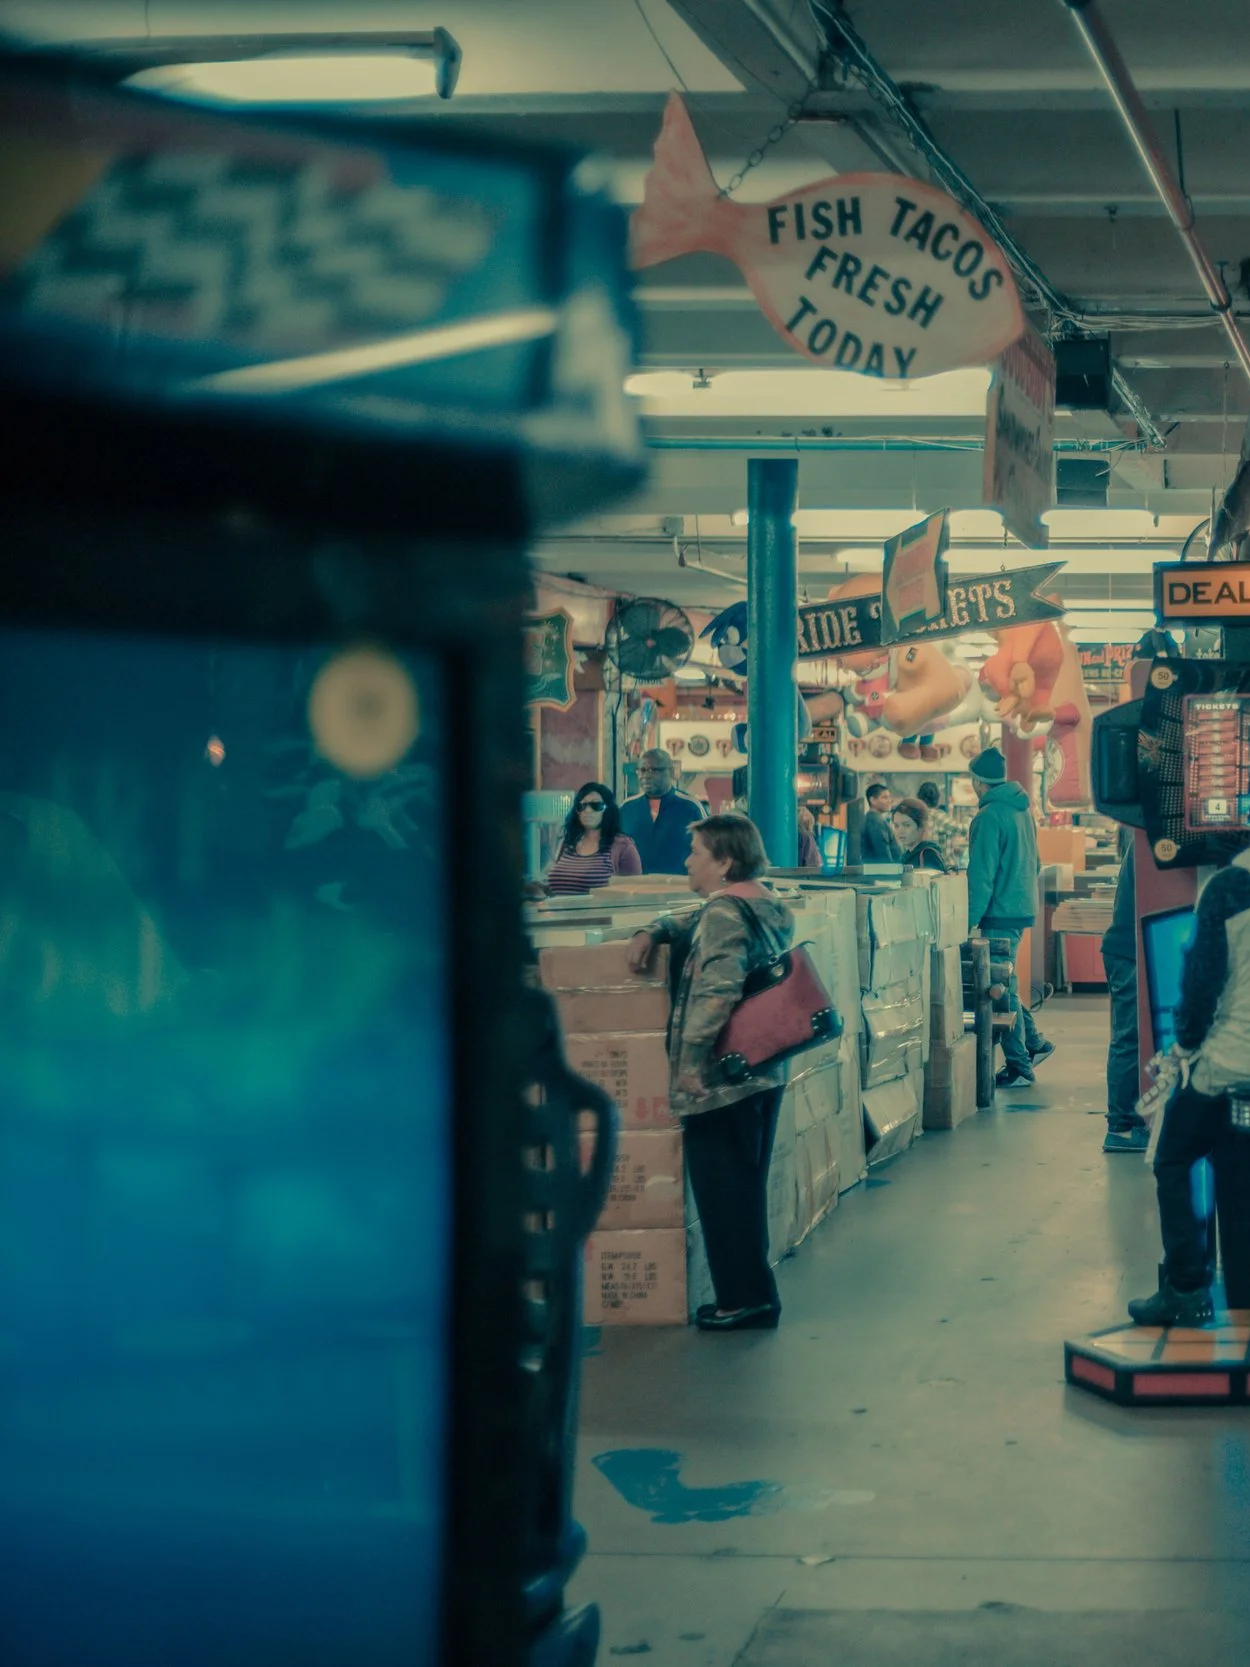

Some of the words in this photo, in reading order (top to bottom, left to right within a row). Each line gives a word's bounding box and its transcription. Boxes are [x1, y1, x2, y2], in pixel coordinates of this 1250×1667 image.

[767, 196, 862, 245] FISH
[888, 196, 1004, 302] TACOS
[805, 245, 944, 330] FRESH
[784, 296, 918, 380] TODAY
[1158, 671, 1170, 681] 50
[1160, 843, 1172, 854] 50
